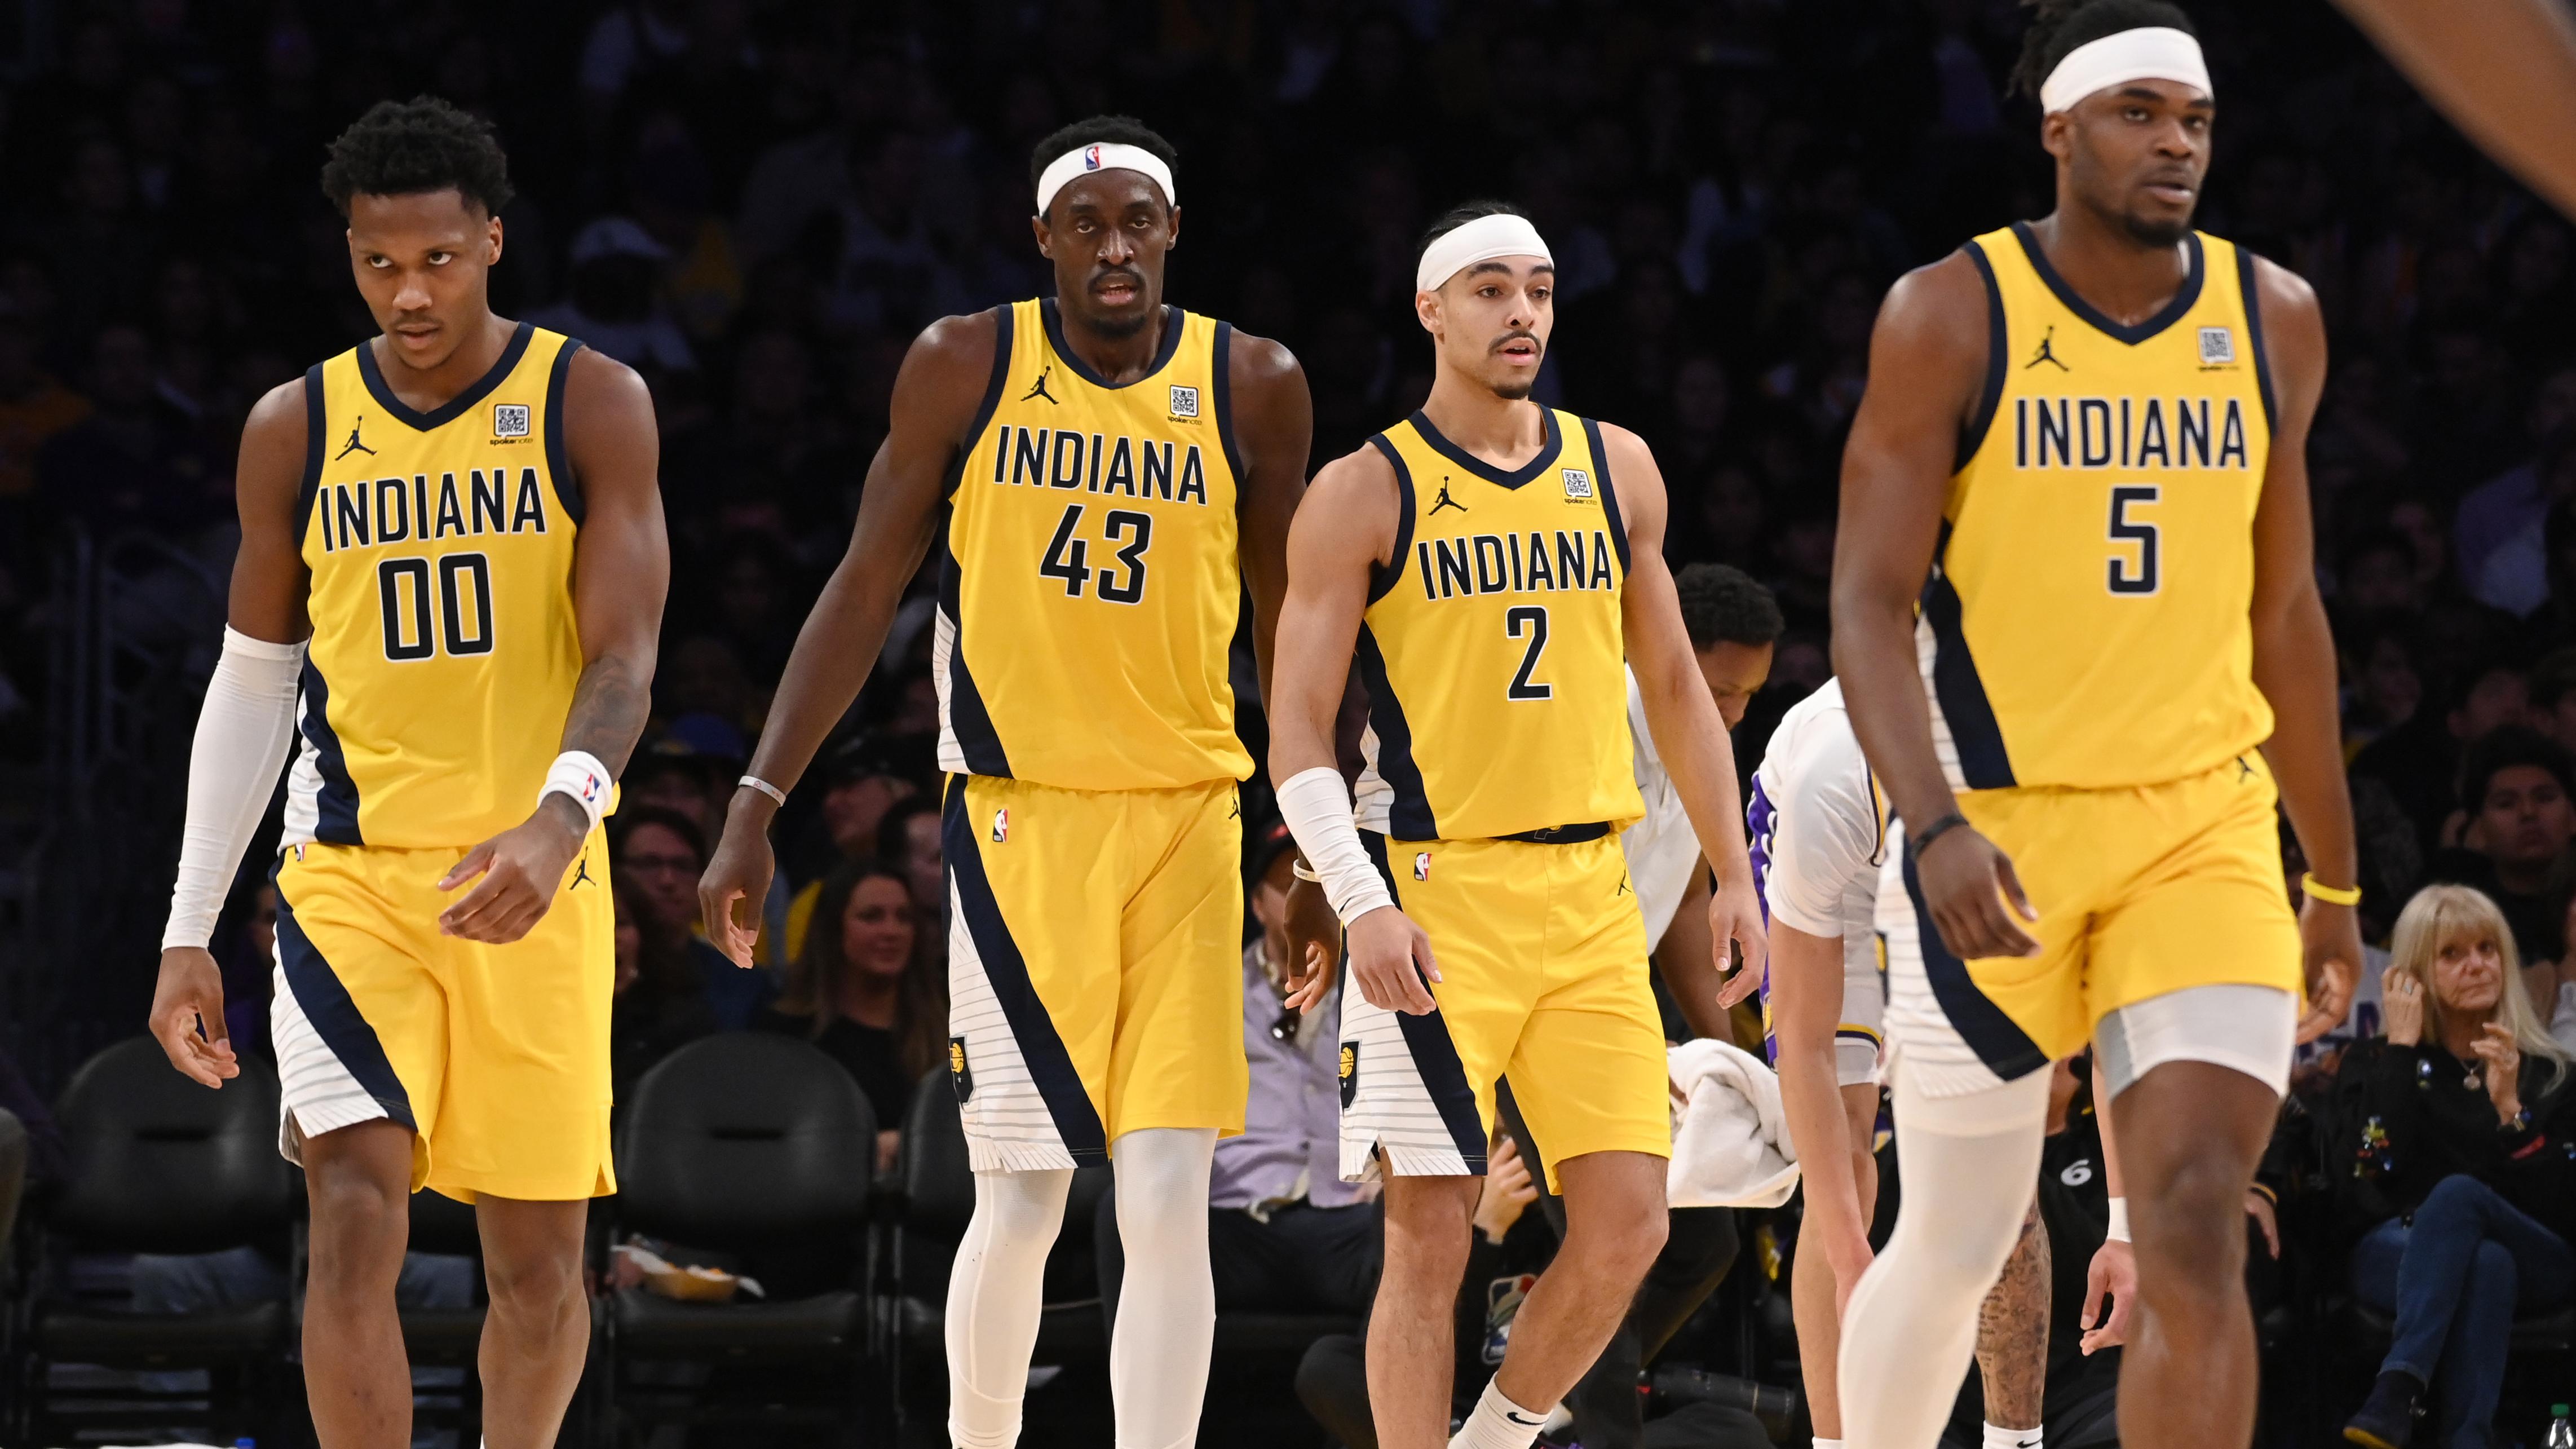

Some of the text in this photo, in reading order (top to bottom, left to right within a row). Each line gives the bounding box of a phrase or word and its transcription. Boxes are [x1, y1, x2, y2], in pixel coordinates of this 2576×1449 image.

[993, 425, 1207, 506] INDIANA
[2015, 398, 2248, 469] INDIANA
[320, 467, 546, 553] INDIANA
[2107, 485, 2159, 595] 5
[1039, 504, 1152, 605] 43
[1417, 531, 1613, 600] INDIANA
[378, 553, 493, 662] 00
[1505, 605, 1553, 701] 2
[2060, 1159, 2092, 1186] 6
